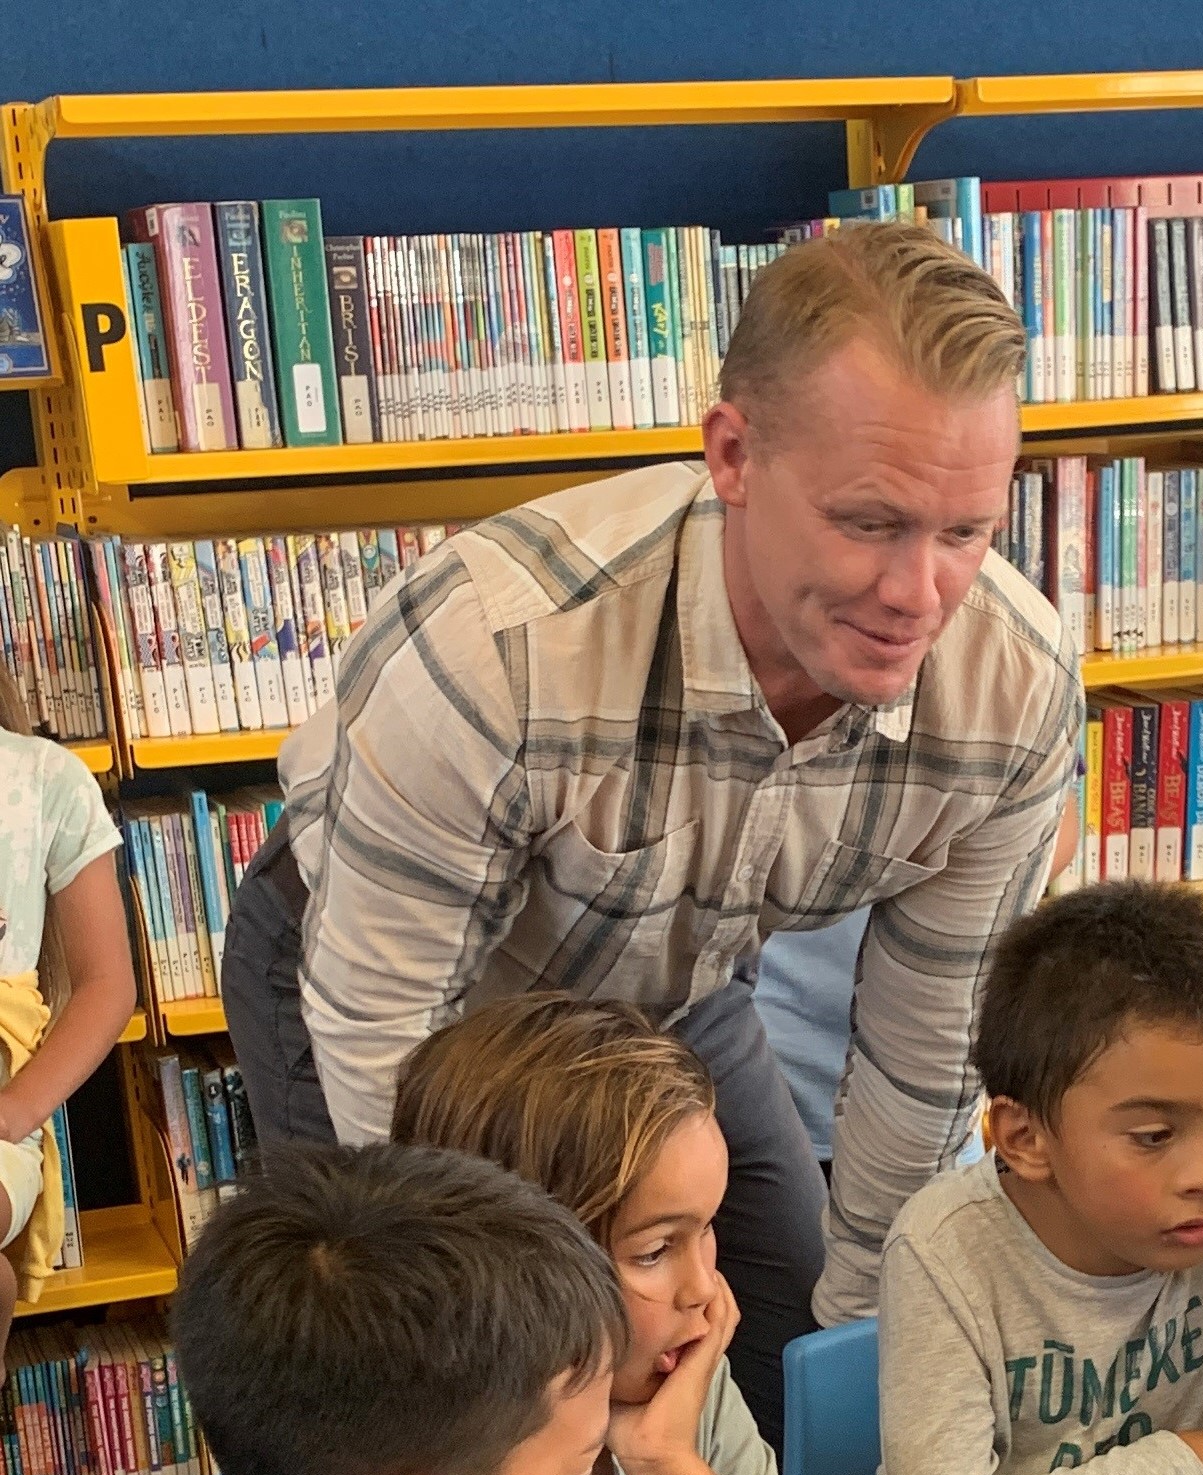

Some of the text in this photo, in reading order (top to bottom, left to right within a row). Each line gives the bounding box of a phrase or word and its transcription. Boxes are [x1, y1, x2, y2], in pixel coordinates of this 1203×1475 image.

[81, 302, 127, 372] P
[231, 253, 264, 382] ERAGON
[1106, 780, 1127, 829] BEAS
[1159, 774, 1181, 826] BEAS
